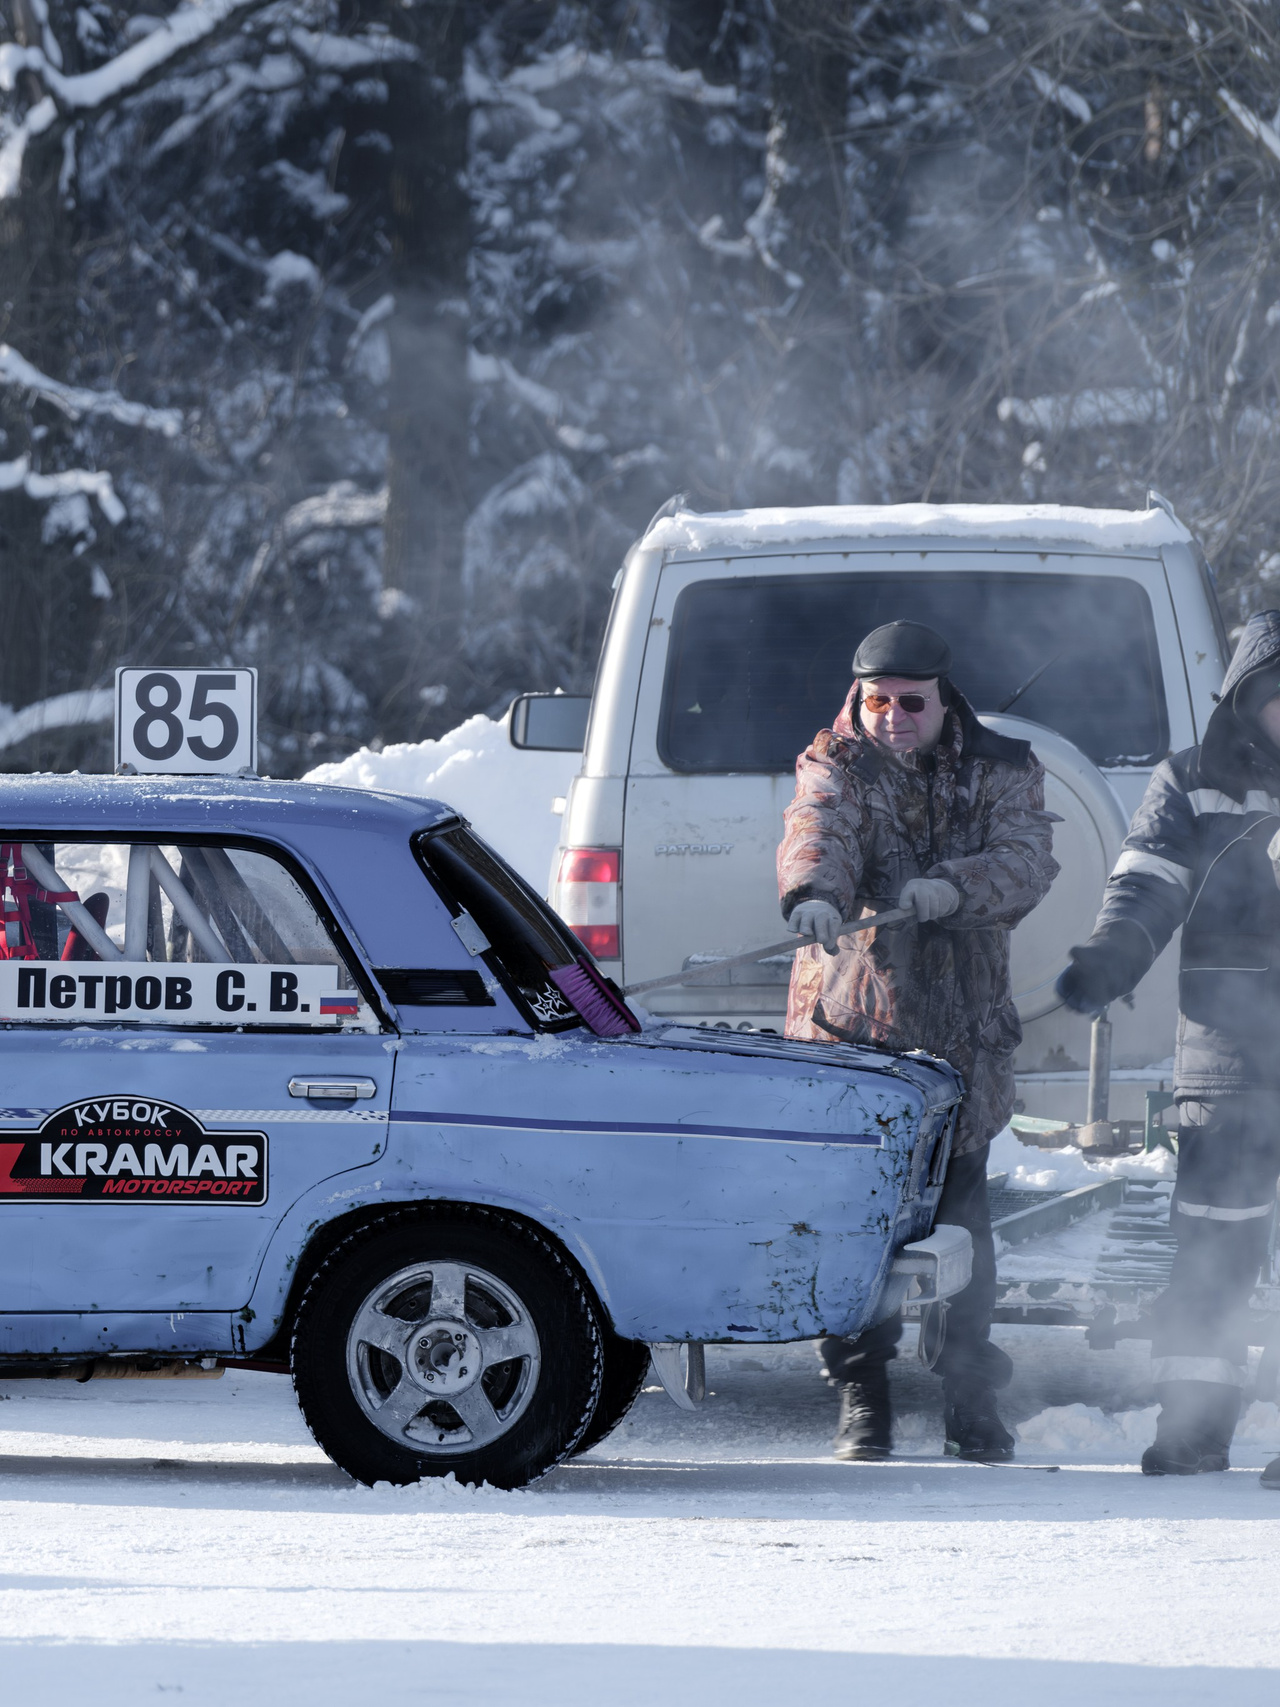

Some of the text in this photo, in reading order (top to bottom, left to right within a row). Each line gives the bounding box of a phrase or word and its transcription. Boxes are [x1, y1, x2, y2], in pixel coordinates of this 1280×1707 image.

[132, 672, 239, 761] 85
[654, 843, 735, 857] PATRIOT
[18, 967, 311, 1013] Петров С. В.
[74, 1101, 171, 1129] КУБОК
[60, 1128, 182, 1137] ПО АВТОКРОССУ
[40, 1143, 259, 1177] KRAMAR
[102, 1179, 258, 1195] MOTORSPORT
